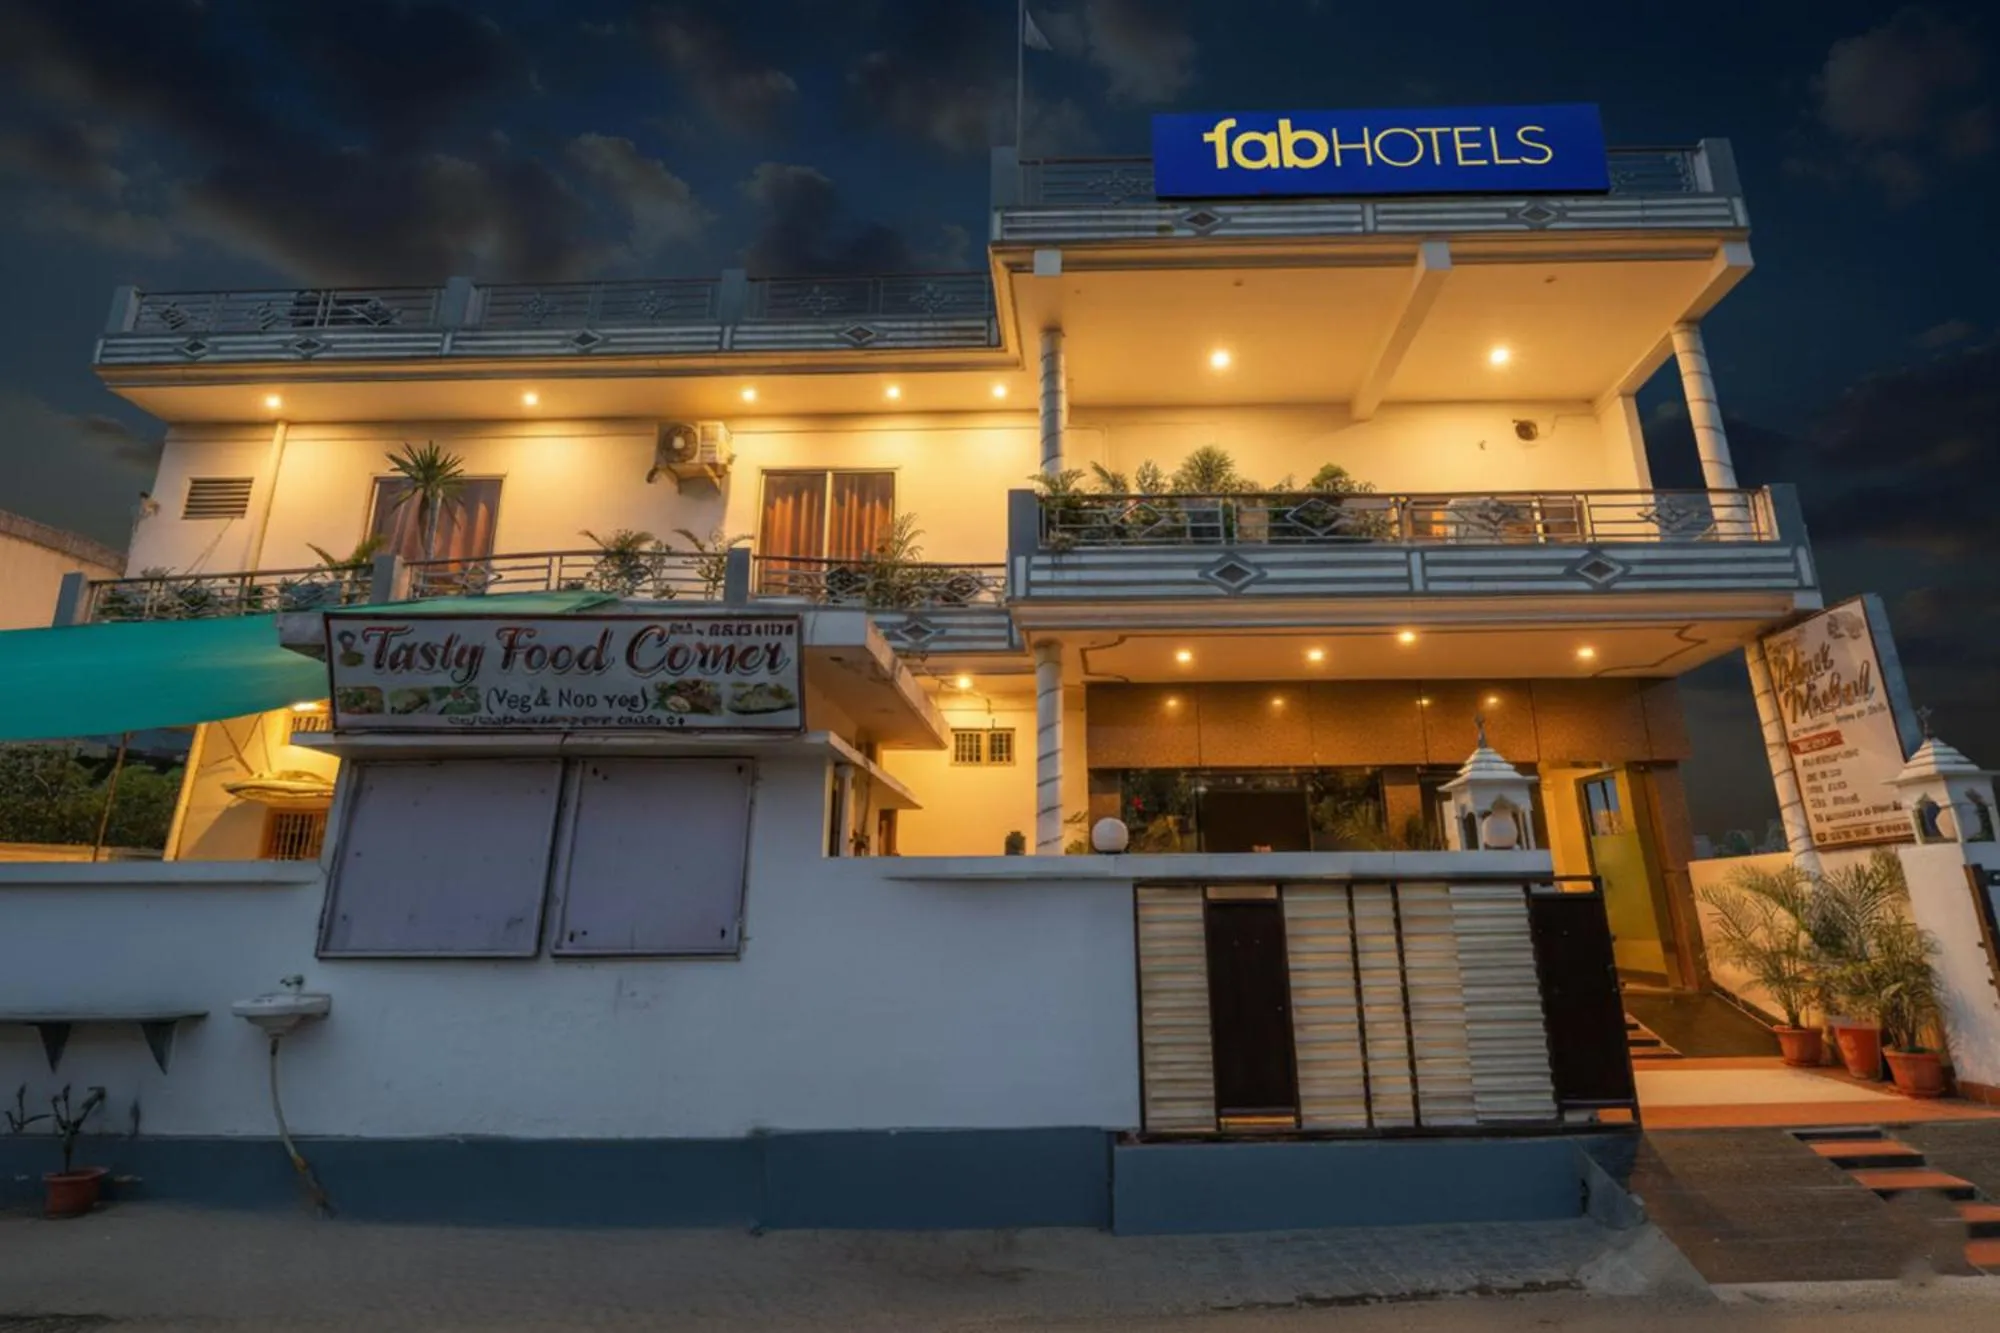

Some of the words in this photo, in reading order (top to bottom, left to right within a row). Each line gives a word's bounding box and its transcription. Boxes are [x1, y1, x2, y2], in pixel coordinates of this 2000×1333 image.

[1203, 117, 1554, 170] fabHOTELS
[361, 624, 486, 686] Tasty
[496, 626, 615, 676] Food
[625, 624, 791, 679] Corner
